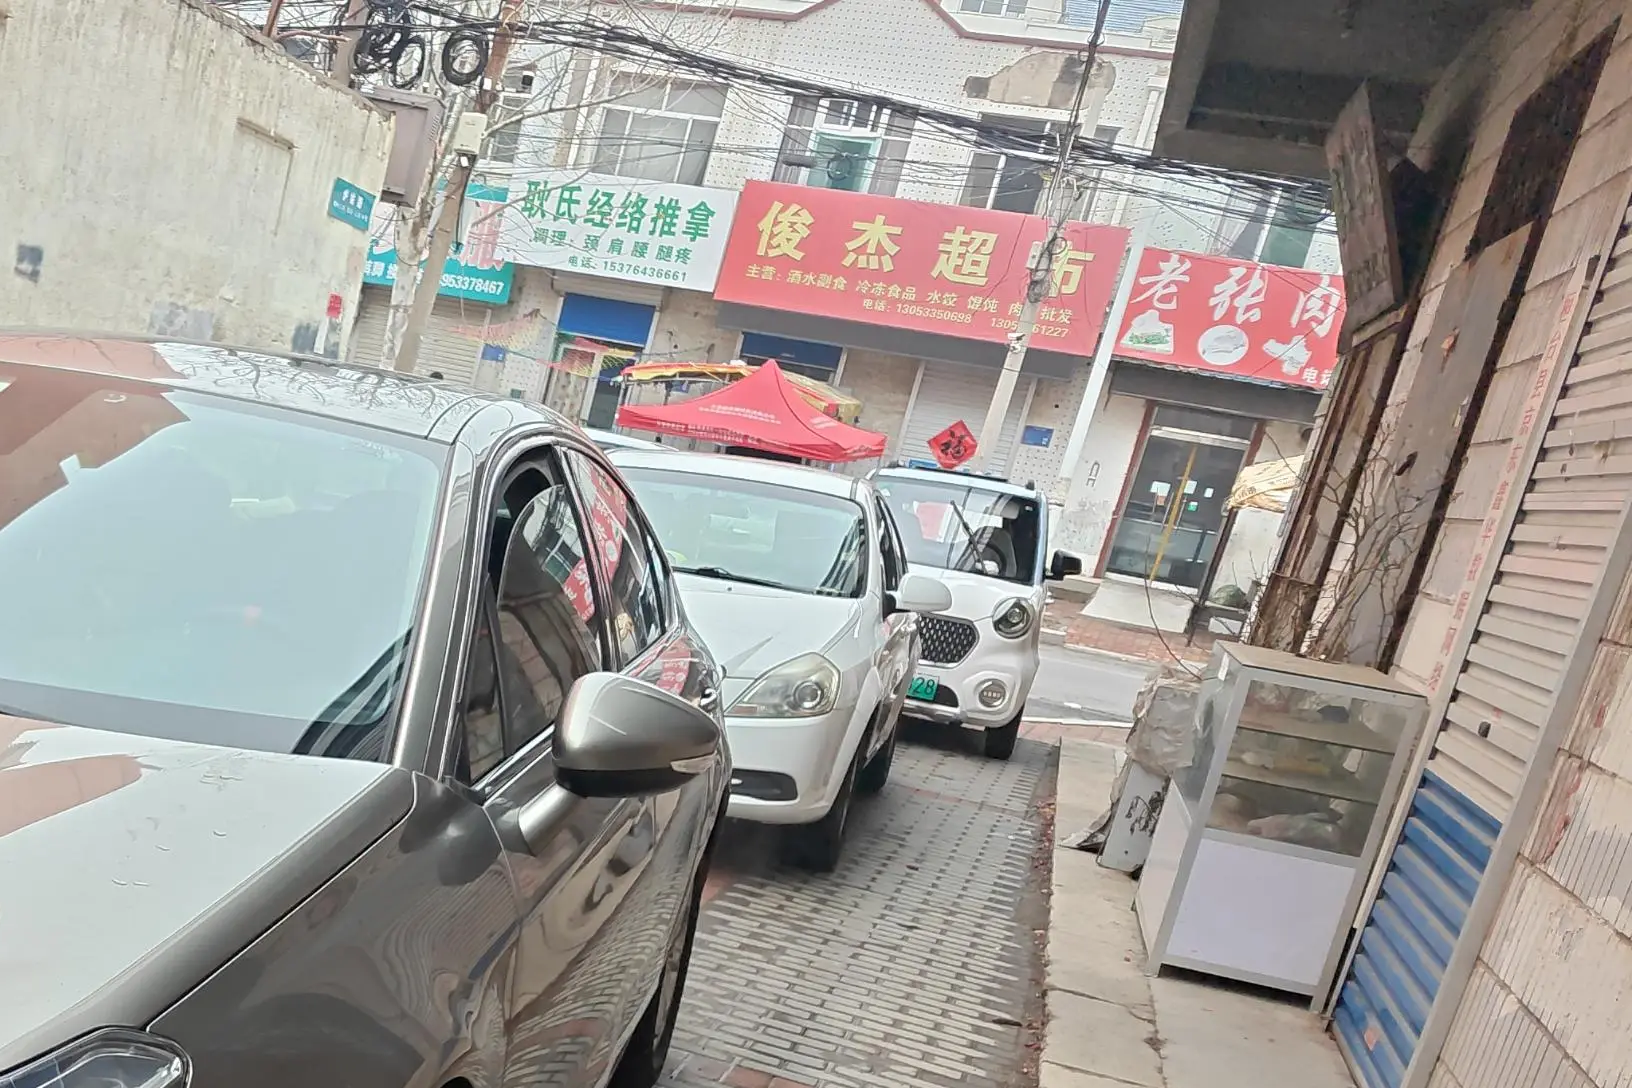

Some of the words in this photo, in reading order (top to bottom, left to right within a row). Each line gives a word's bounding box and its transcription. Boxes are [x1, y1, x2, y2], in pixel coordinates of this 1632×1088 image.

[521, 180, 716, 242] 耿氏经络推拿
[991, 318, 1069, 338] 130561227
